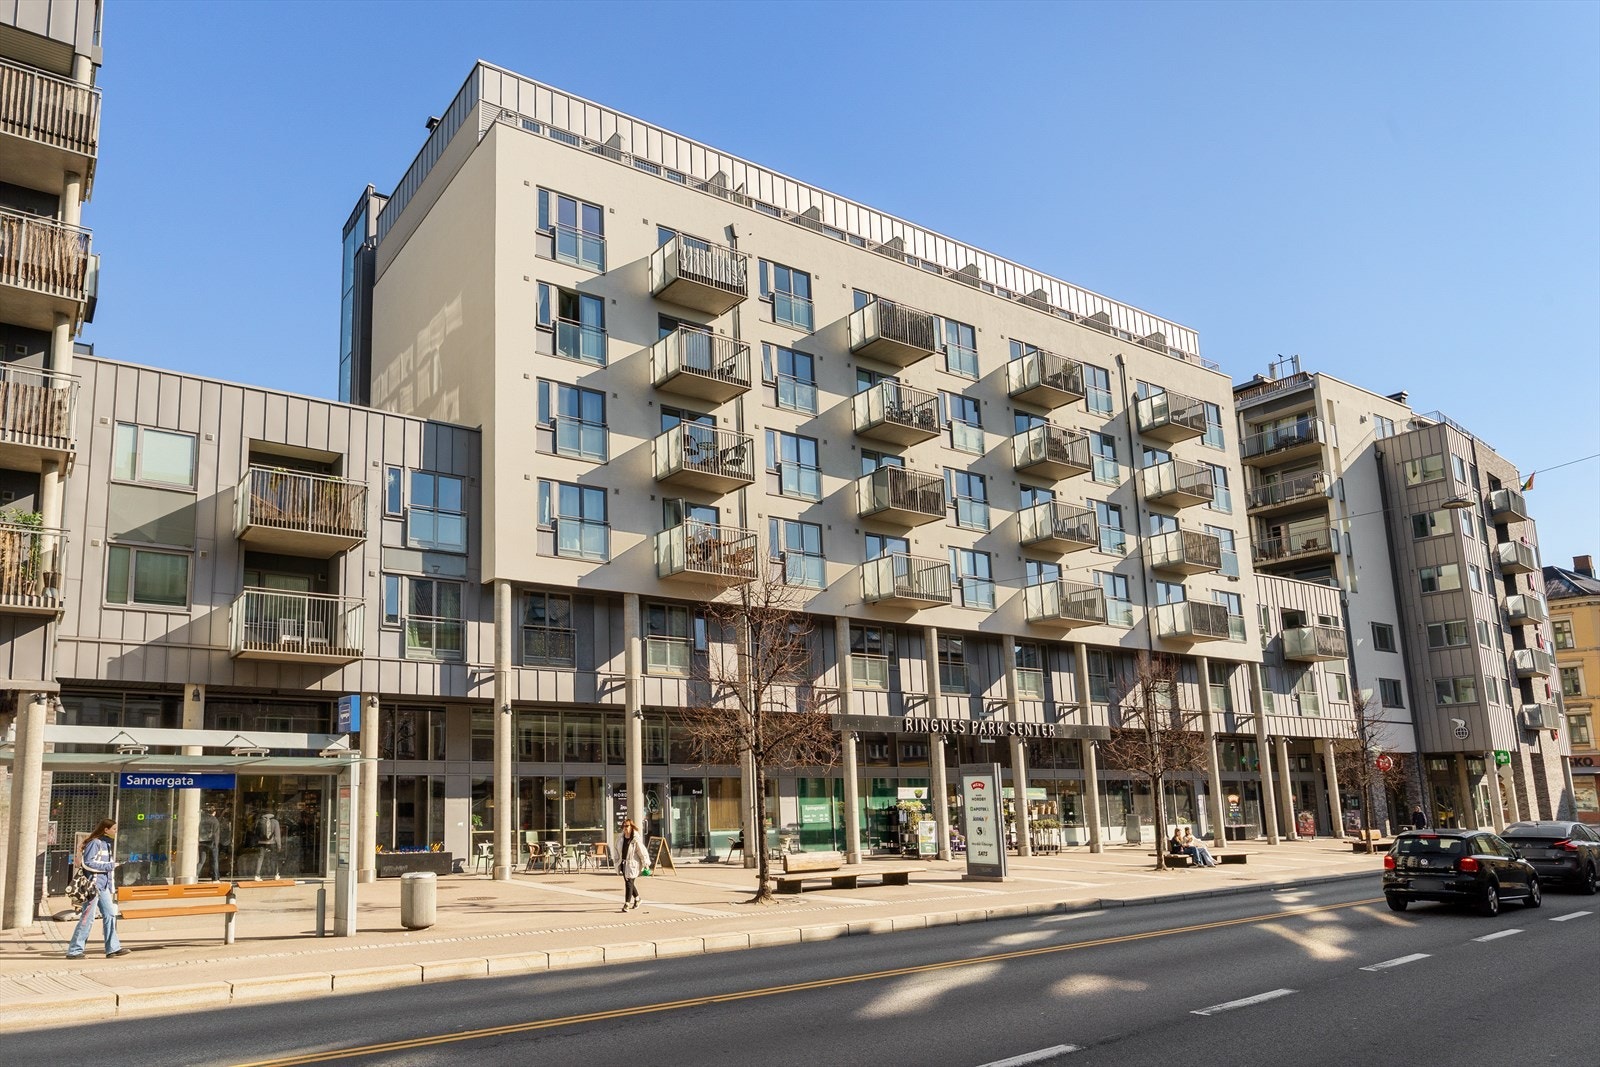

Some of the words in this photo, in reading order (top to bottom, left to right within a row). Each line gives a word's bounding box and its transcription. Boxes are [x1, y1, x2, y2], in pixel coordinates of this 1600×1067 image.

[906, 718, 966, 733] RINGNES
[972, 720, 1004, 735] PARK
[1009, 722, 1056, 736] SENTER
[126, 775, 194, 787] Sannergata
